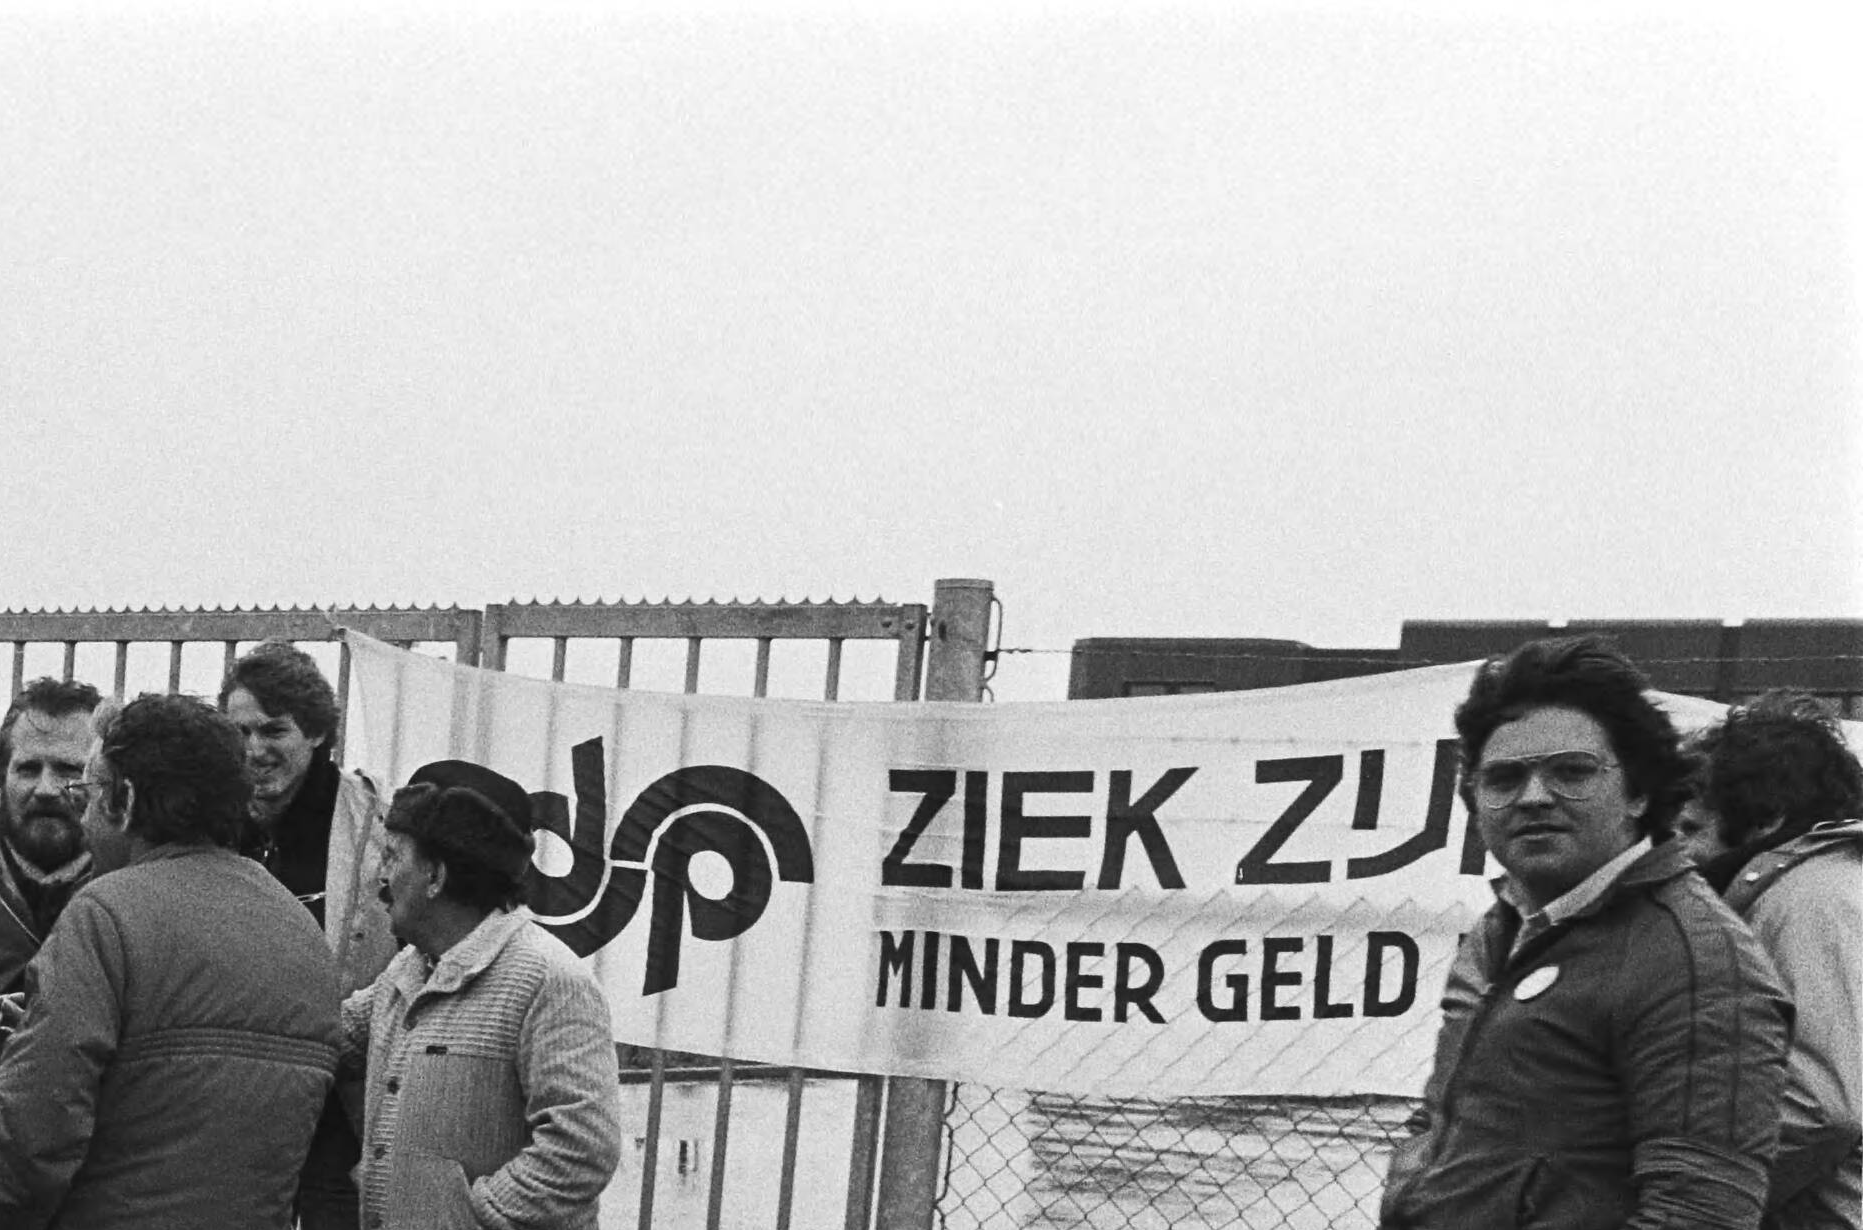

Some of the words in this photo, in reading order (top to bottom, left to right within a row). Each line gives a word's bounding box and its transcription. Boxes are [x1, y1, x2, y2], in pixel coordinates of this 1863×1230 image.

[879, 766, 1199, 892] ZIEK
[1234, 735, 1488, 886] ZIJ
[875, 929, 1168, 1024] MINDER
[1195, 930, 1421, 1024] GELD
